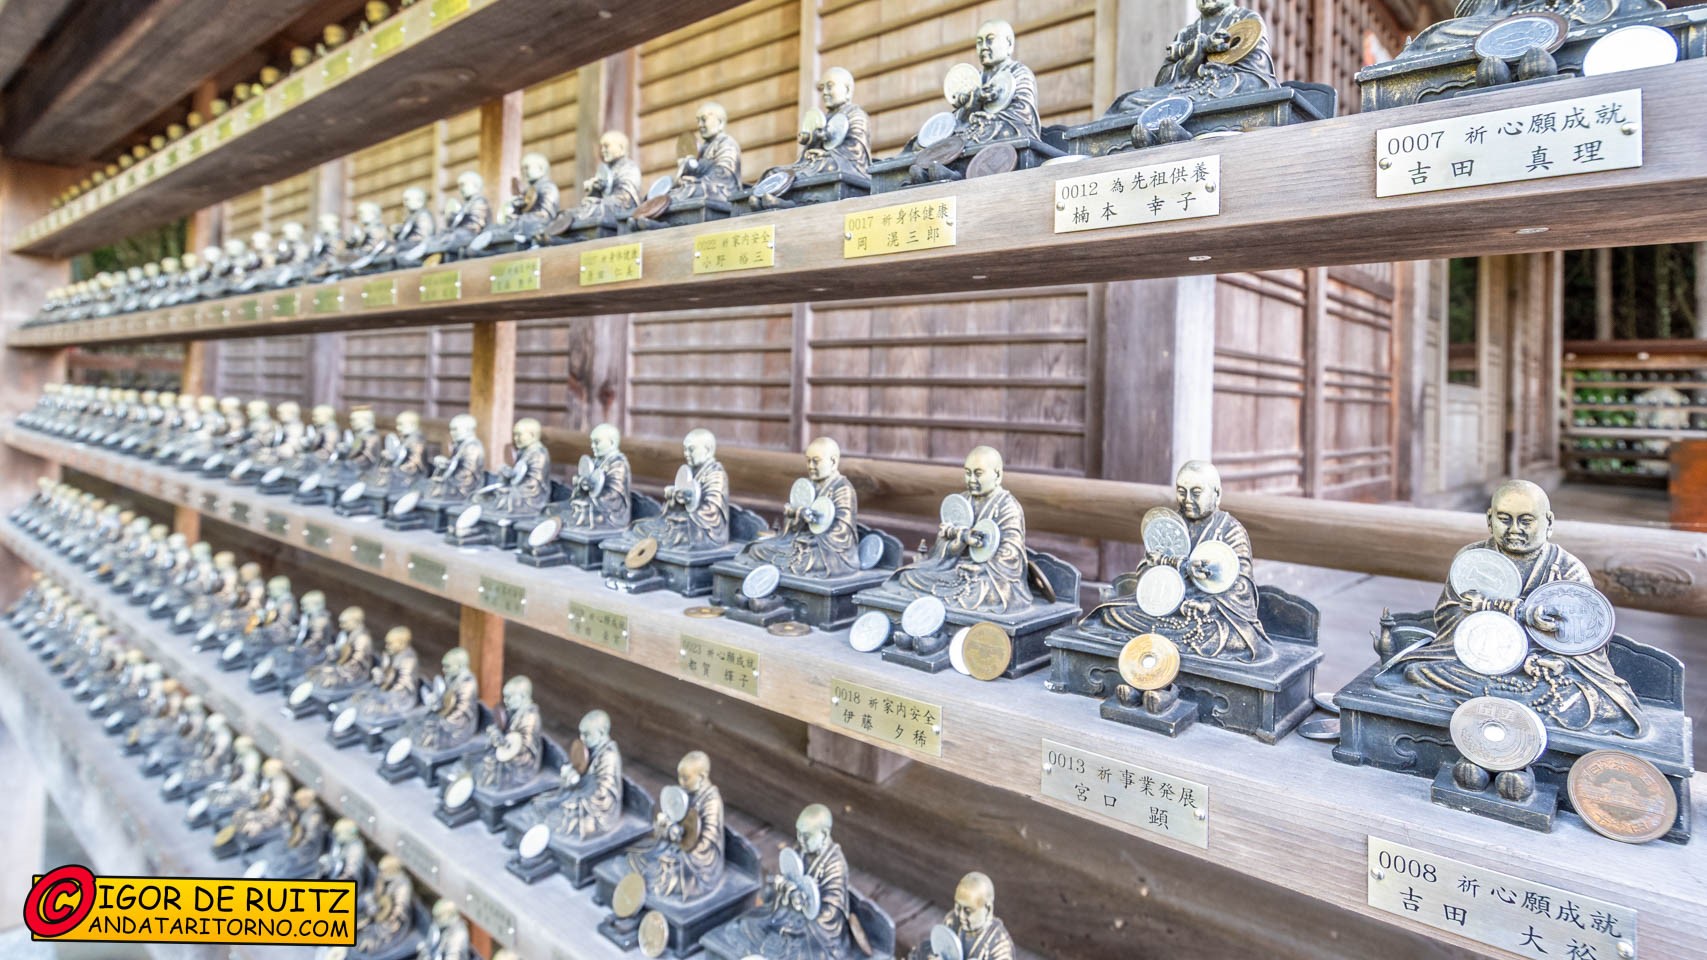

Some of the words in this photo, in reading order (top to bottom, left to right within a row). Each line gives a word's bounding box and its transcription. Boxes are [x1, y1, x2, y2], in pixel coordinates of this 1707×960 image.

[1387, 130, 1446, 156] 0007
[1061, 181, 1099, 200] 0012
[848, 215, 874, 232] 0017
[834, 685, 861, 705] 0018
[1048, 750, 1086, 775] 0013
[1378, 849, 1439, 884] 0008
